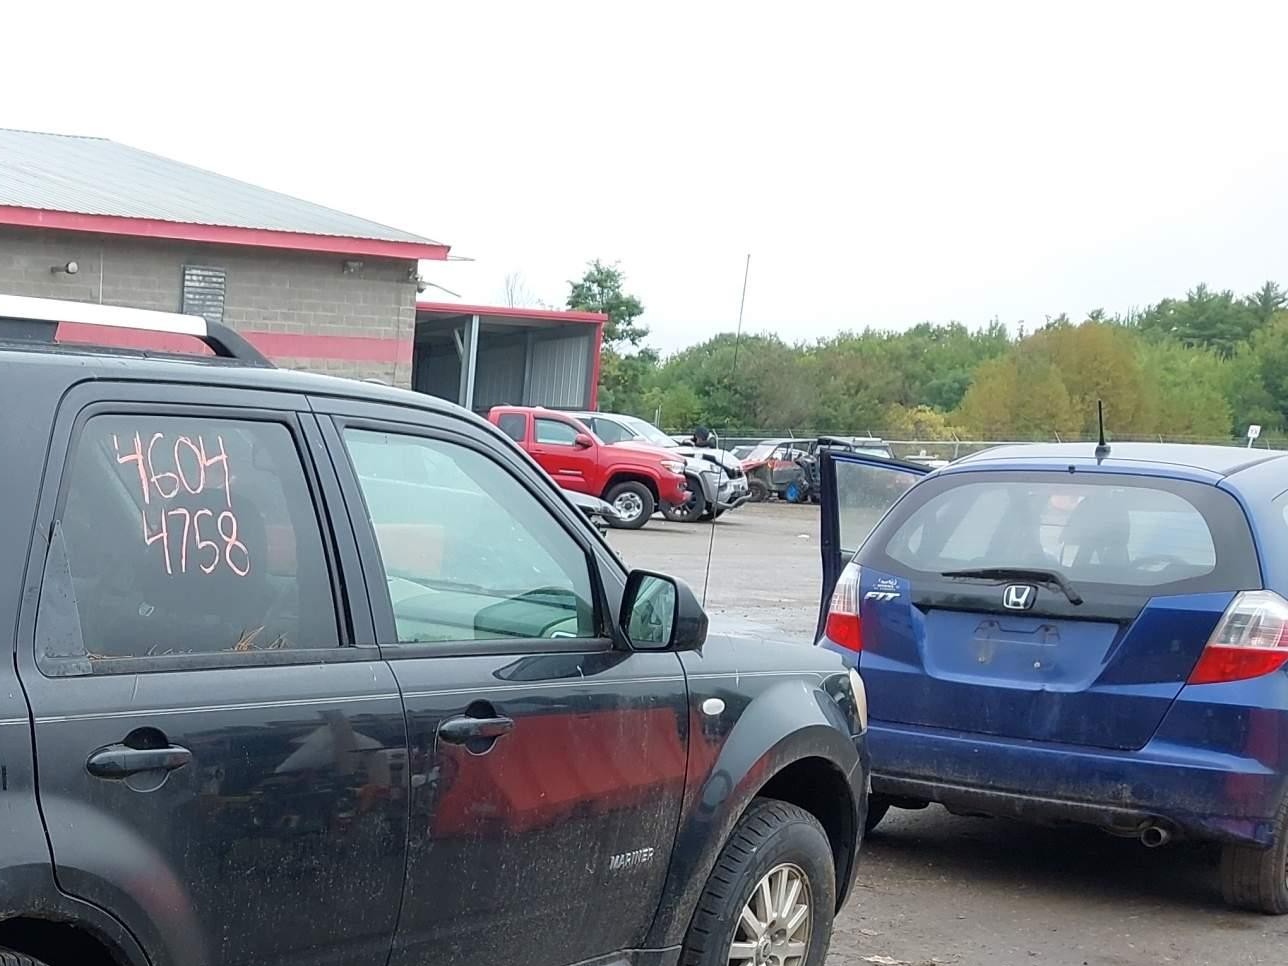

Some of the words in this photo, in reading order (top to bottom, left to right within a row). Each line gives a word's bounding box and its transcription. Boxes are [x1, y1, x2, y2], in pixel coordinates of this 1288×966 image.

[113, 430, 232, 508] 4604
[142, 508, 250, 576] 4758
[864, 591, 901, 601] FIT
[609, 847, 654, 870] MARINER
